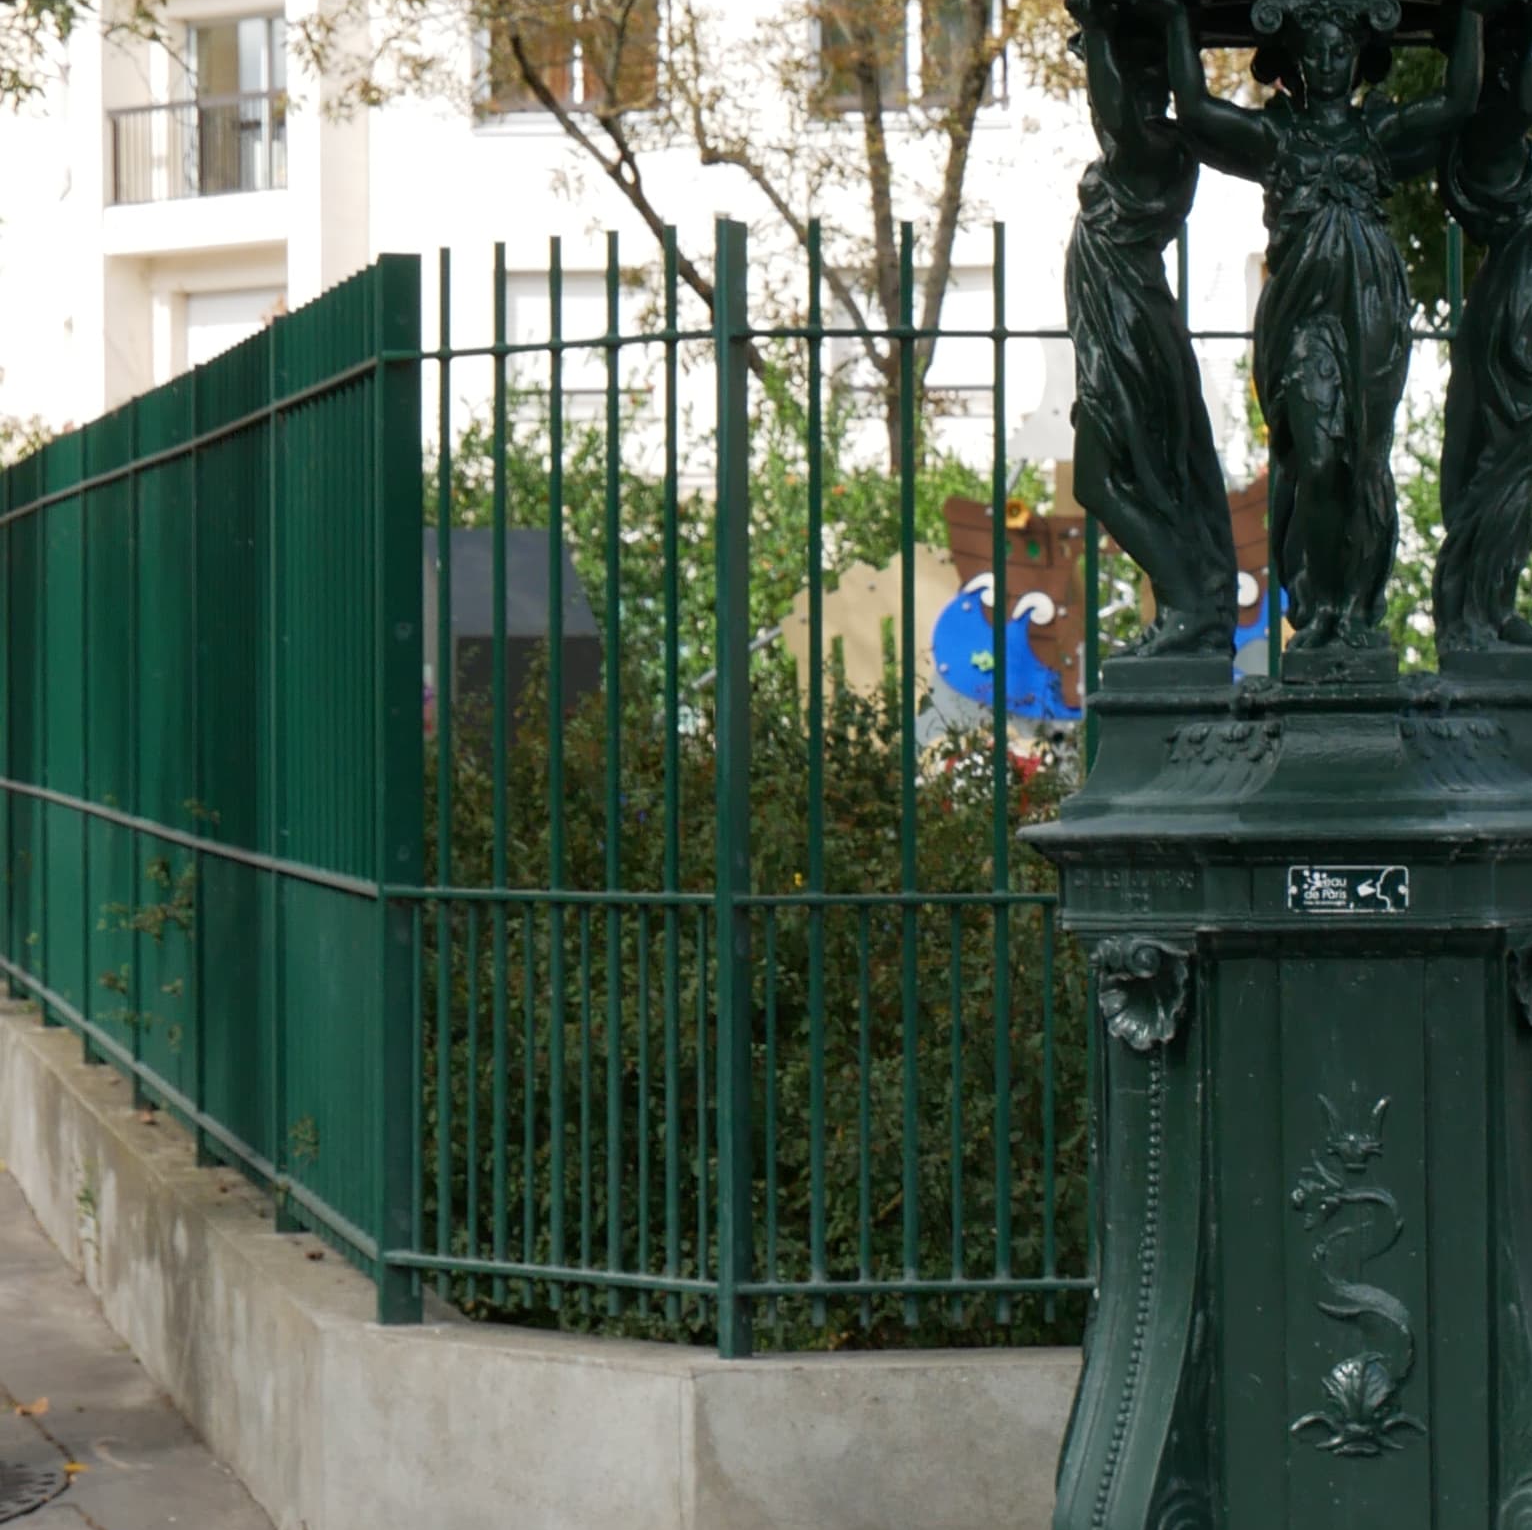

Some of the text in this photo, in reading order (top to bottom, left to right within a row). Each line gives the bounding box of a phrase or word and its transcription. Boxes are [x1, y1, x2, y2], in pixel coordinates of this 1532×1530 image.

[1321, 877, 1347, 887] eau
[1303, 889, 1347, 900] de Paris
